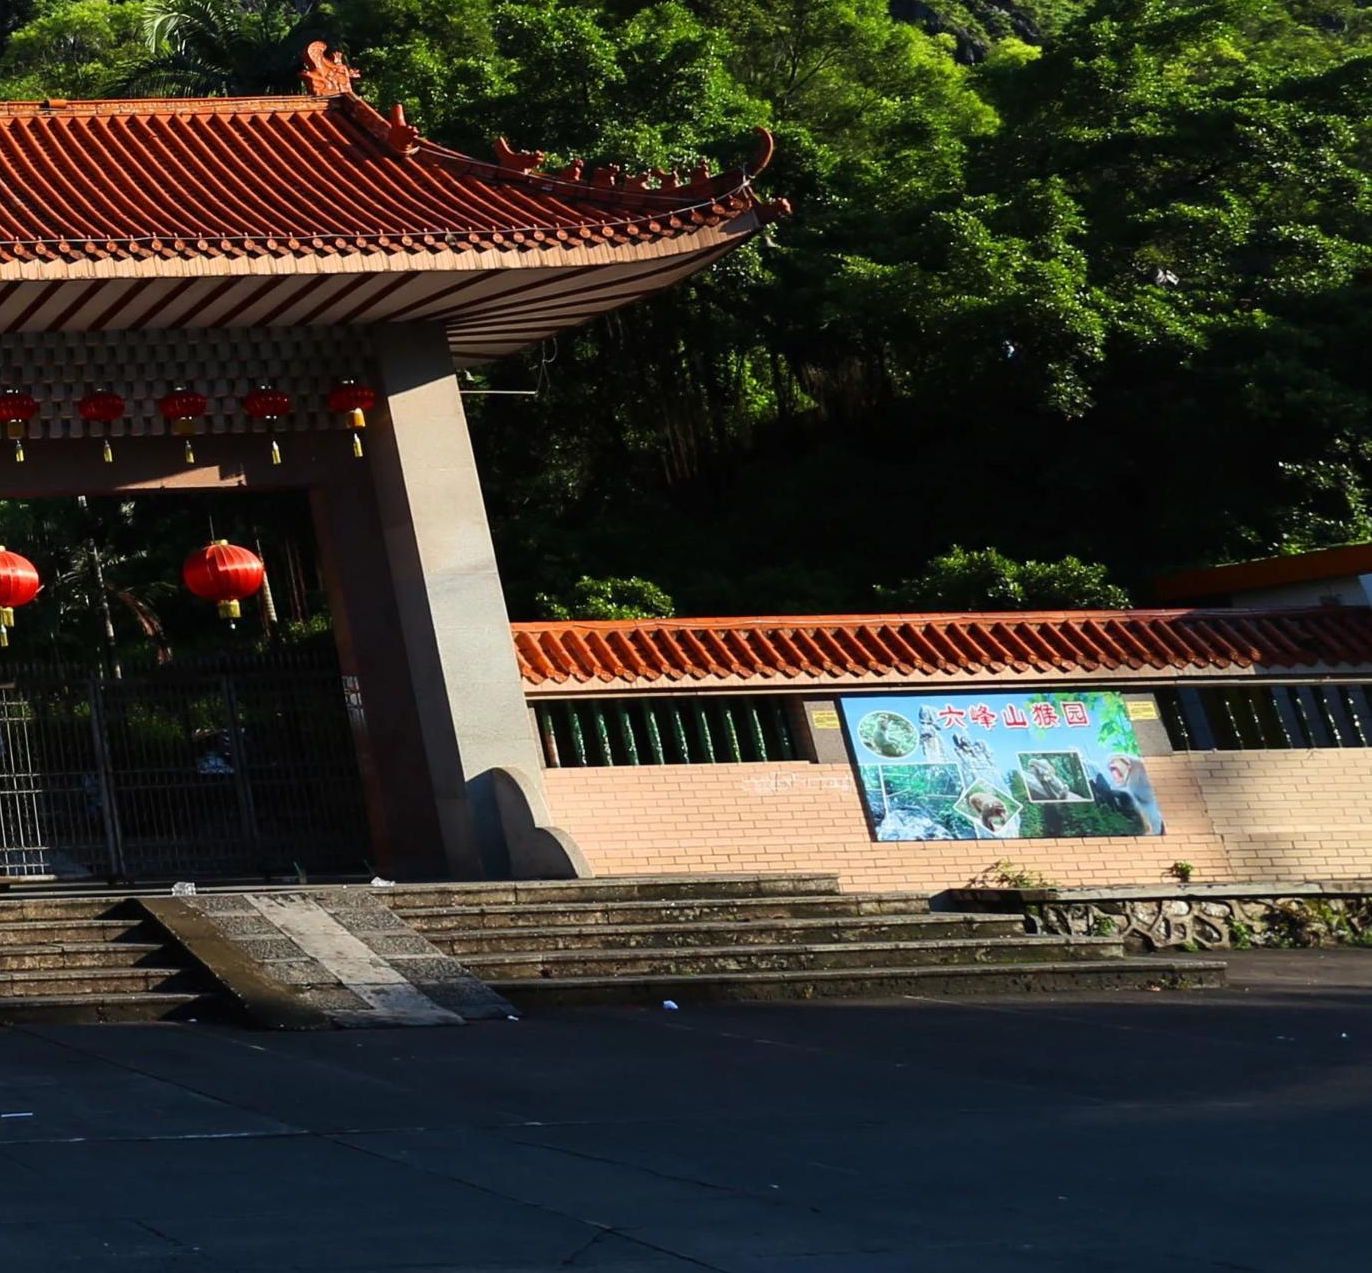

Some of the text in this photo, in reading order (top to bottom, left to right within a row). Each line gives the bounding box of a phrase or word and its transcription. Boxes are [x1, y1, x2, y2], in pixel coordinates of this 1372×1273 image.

[939, 702, 1089, 729] 六峰山猴园
